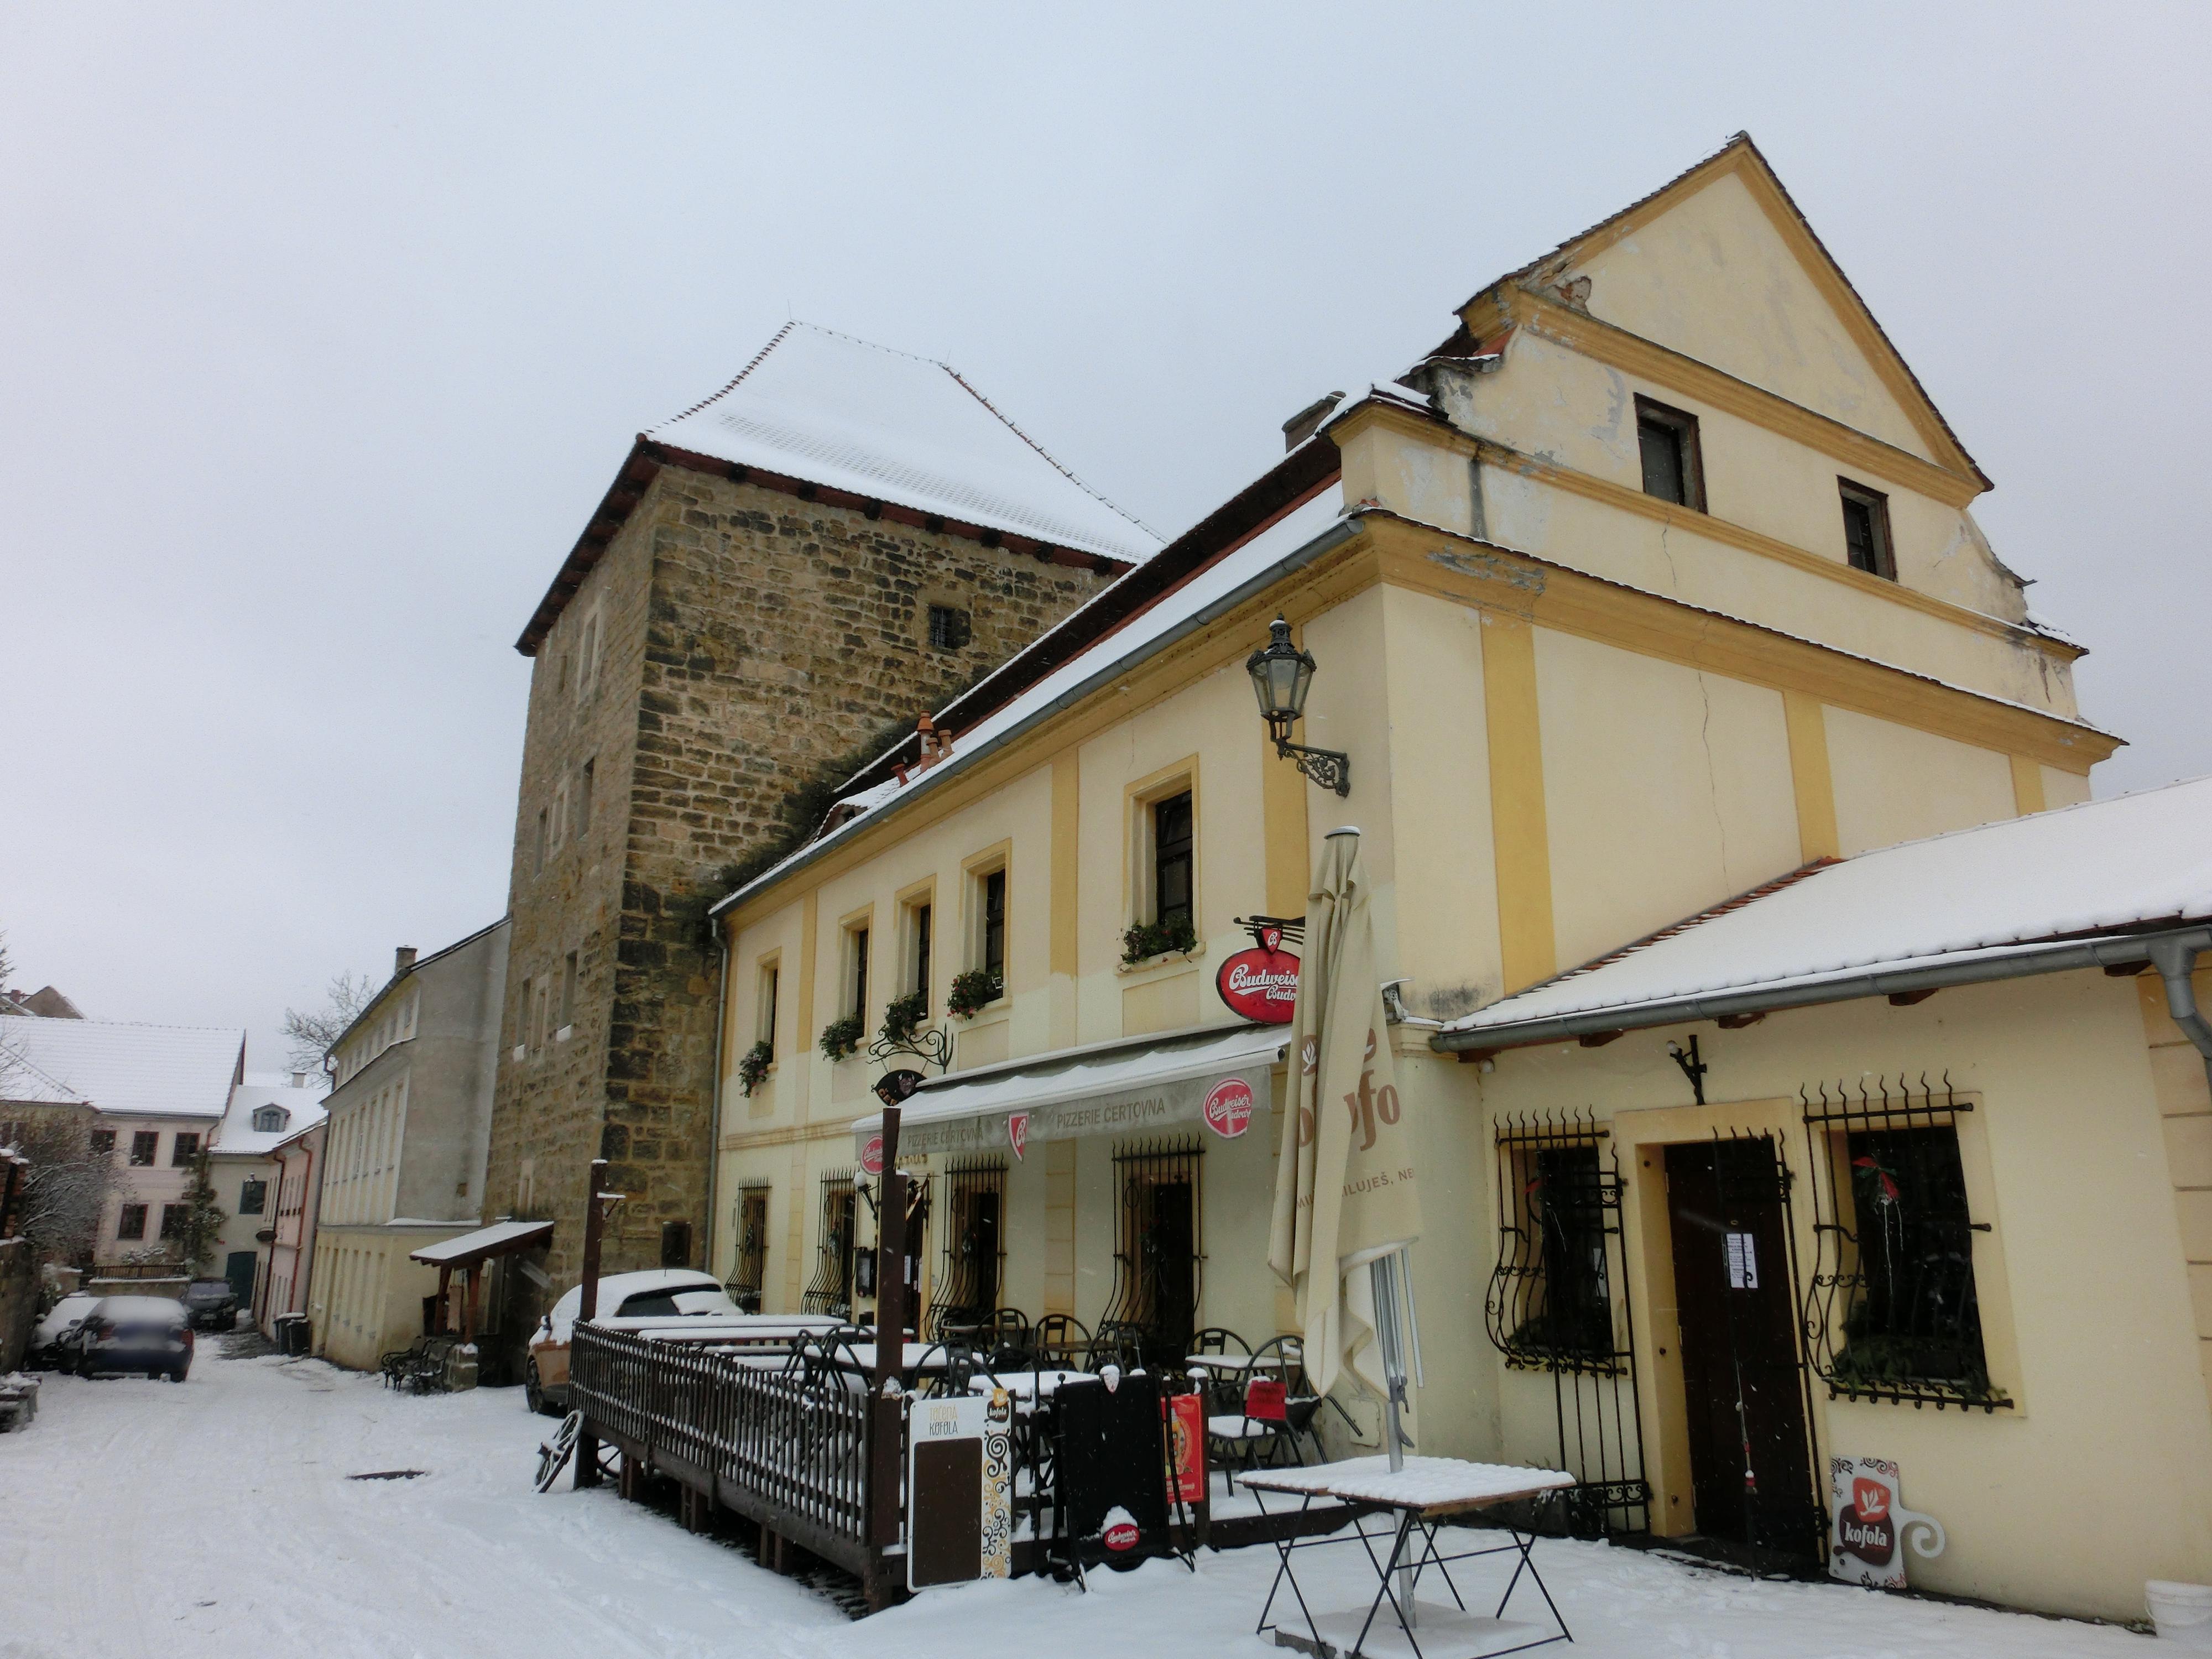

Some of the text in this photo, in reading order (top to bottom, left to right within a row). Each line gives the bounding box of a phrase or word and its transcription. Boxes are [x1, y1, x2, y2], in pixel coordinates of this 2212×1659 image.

[1057, 1098, 1166, 1129] PIZZERIE ČERTOVNA
[907, 1131, 939, 1148] PIZZERIE
[1342, 1171, 1394, 1197] ILUJEŠ,
[989, 1407, 1007, 1418] kofola
[930, 1421, 958, 1436] KOFOLA
[1844, 1521, 1887, 1549] kofola
